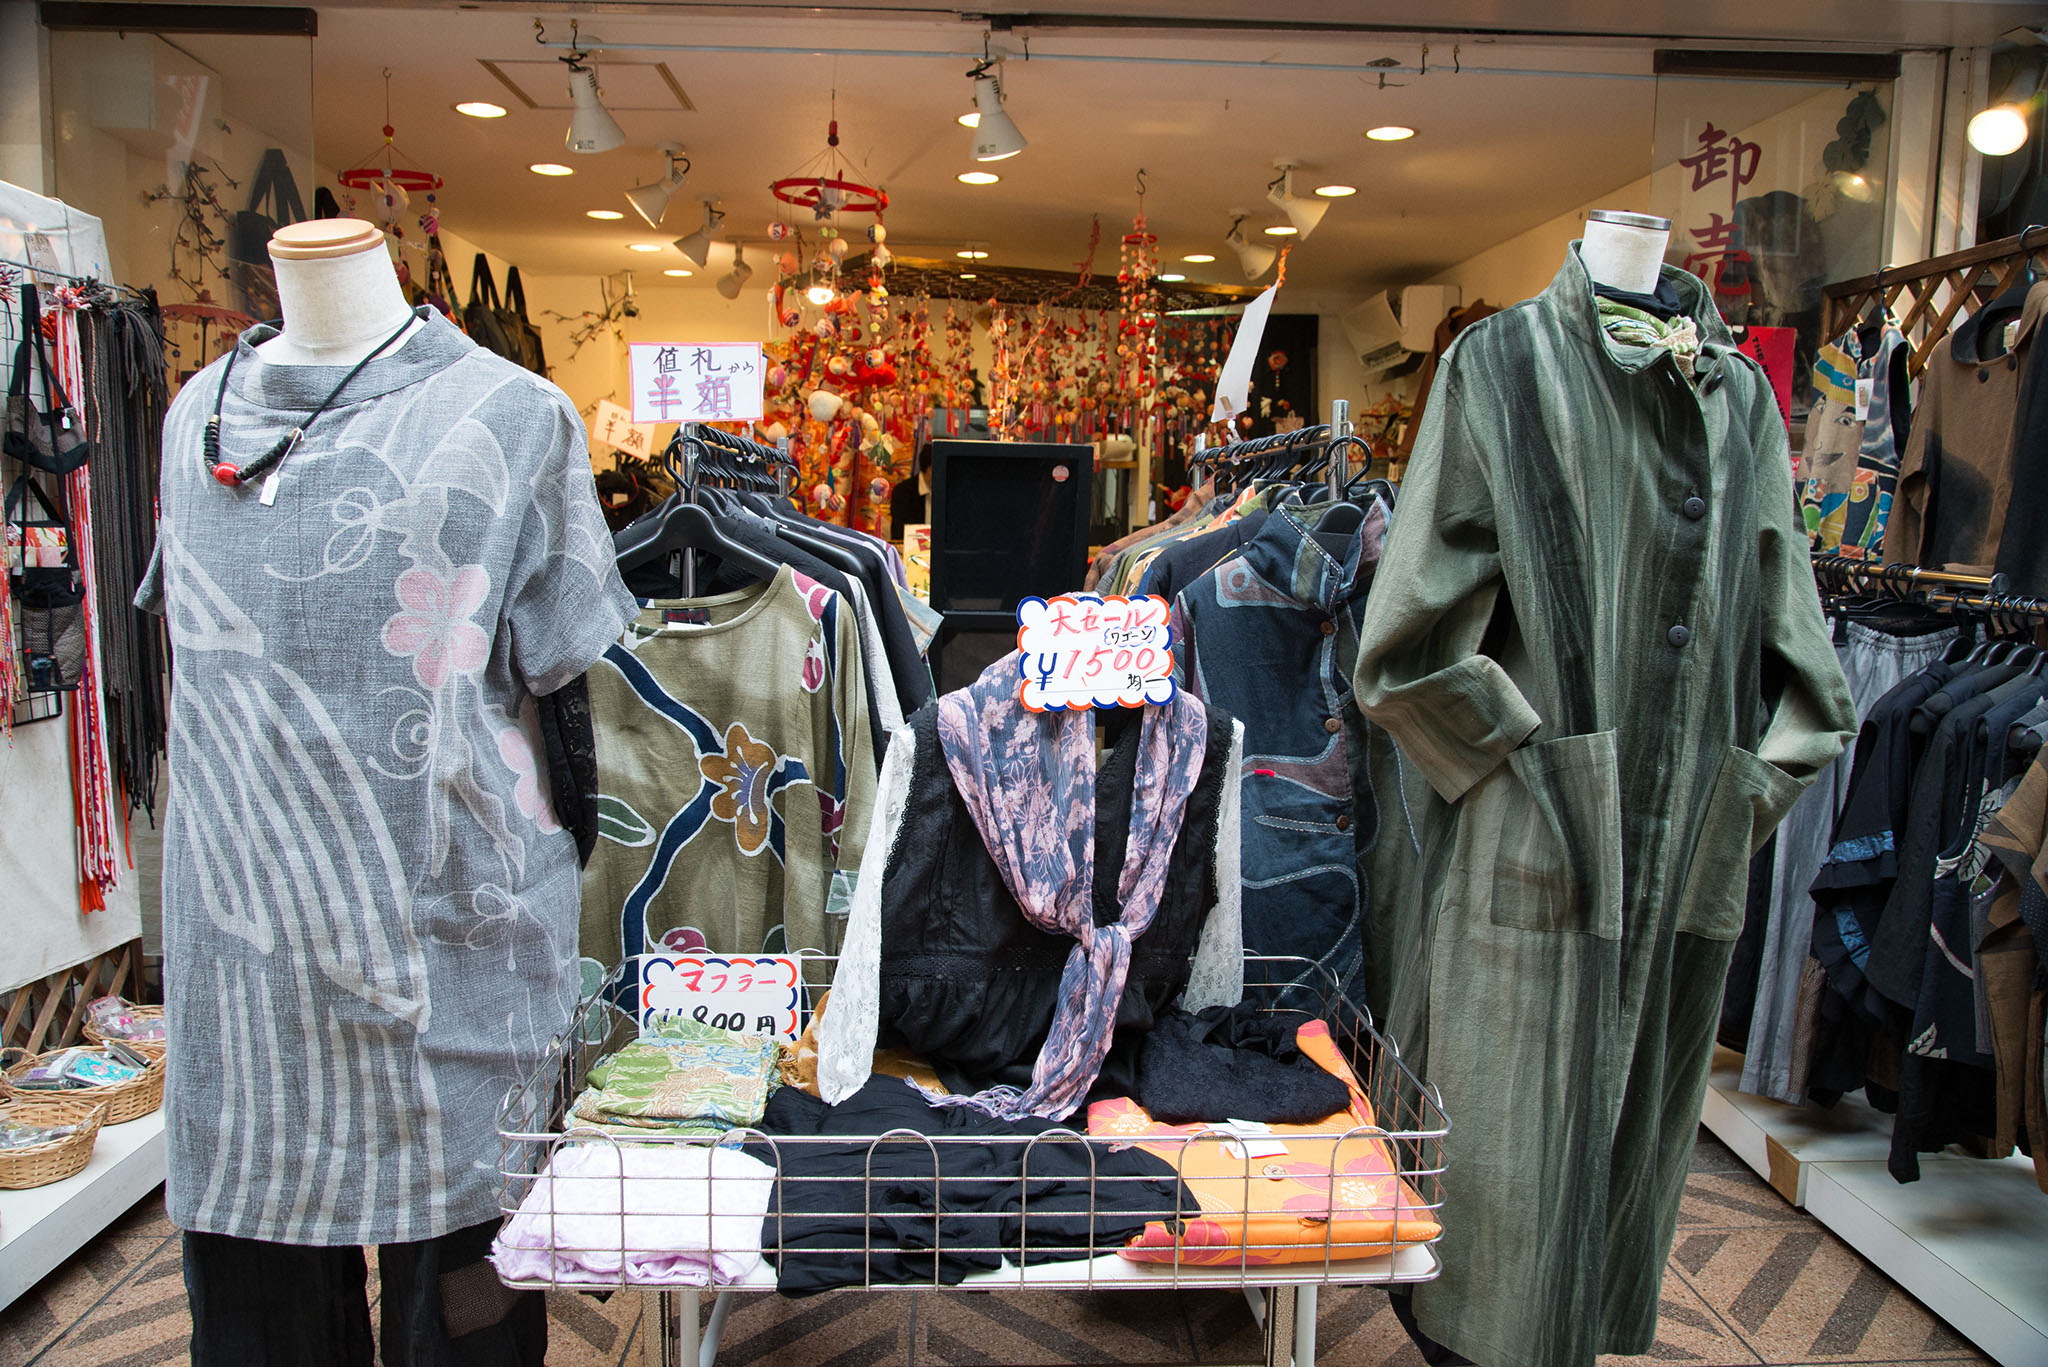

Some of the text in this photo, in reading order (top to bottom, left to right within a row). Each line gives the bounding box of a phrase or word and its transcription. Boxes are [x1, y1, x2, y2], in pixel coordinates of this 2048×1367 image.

[1679, 121, 1762, 325] 卸売
[653, 346, 755, 375] 値札から
[1752, 336, 1765, 361] THE
[647, 373, 733, 419] 半額
[1050, 604, 1158, 637] 大セール
[1126, 673, 1167, 692] 均一
[680, 969, 777, 994] マフラー
